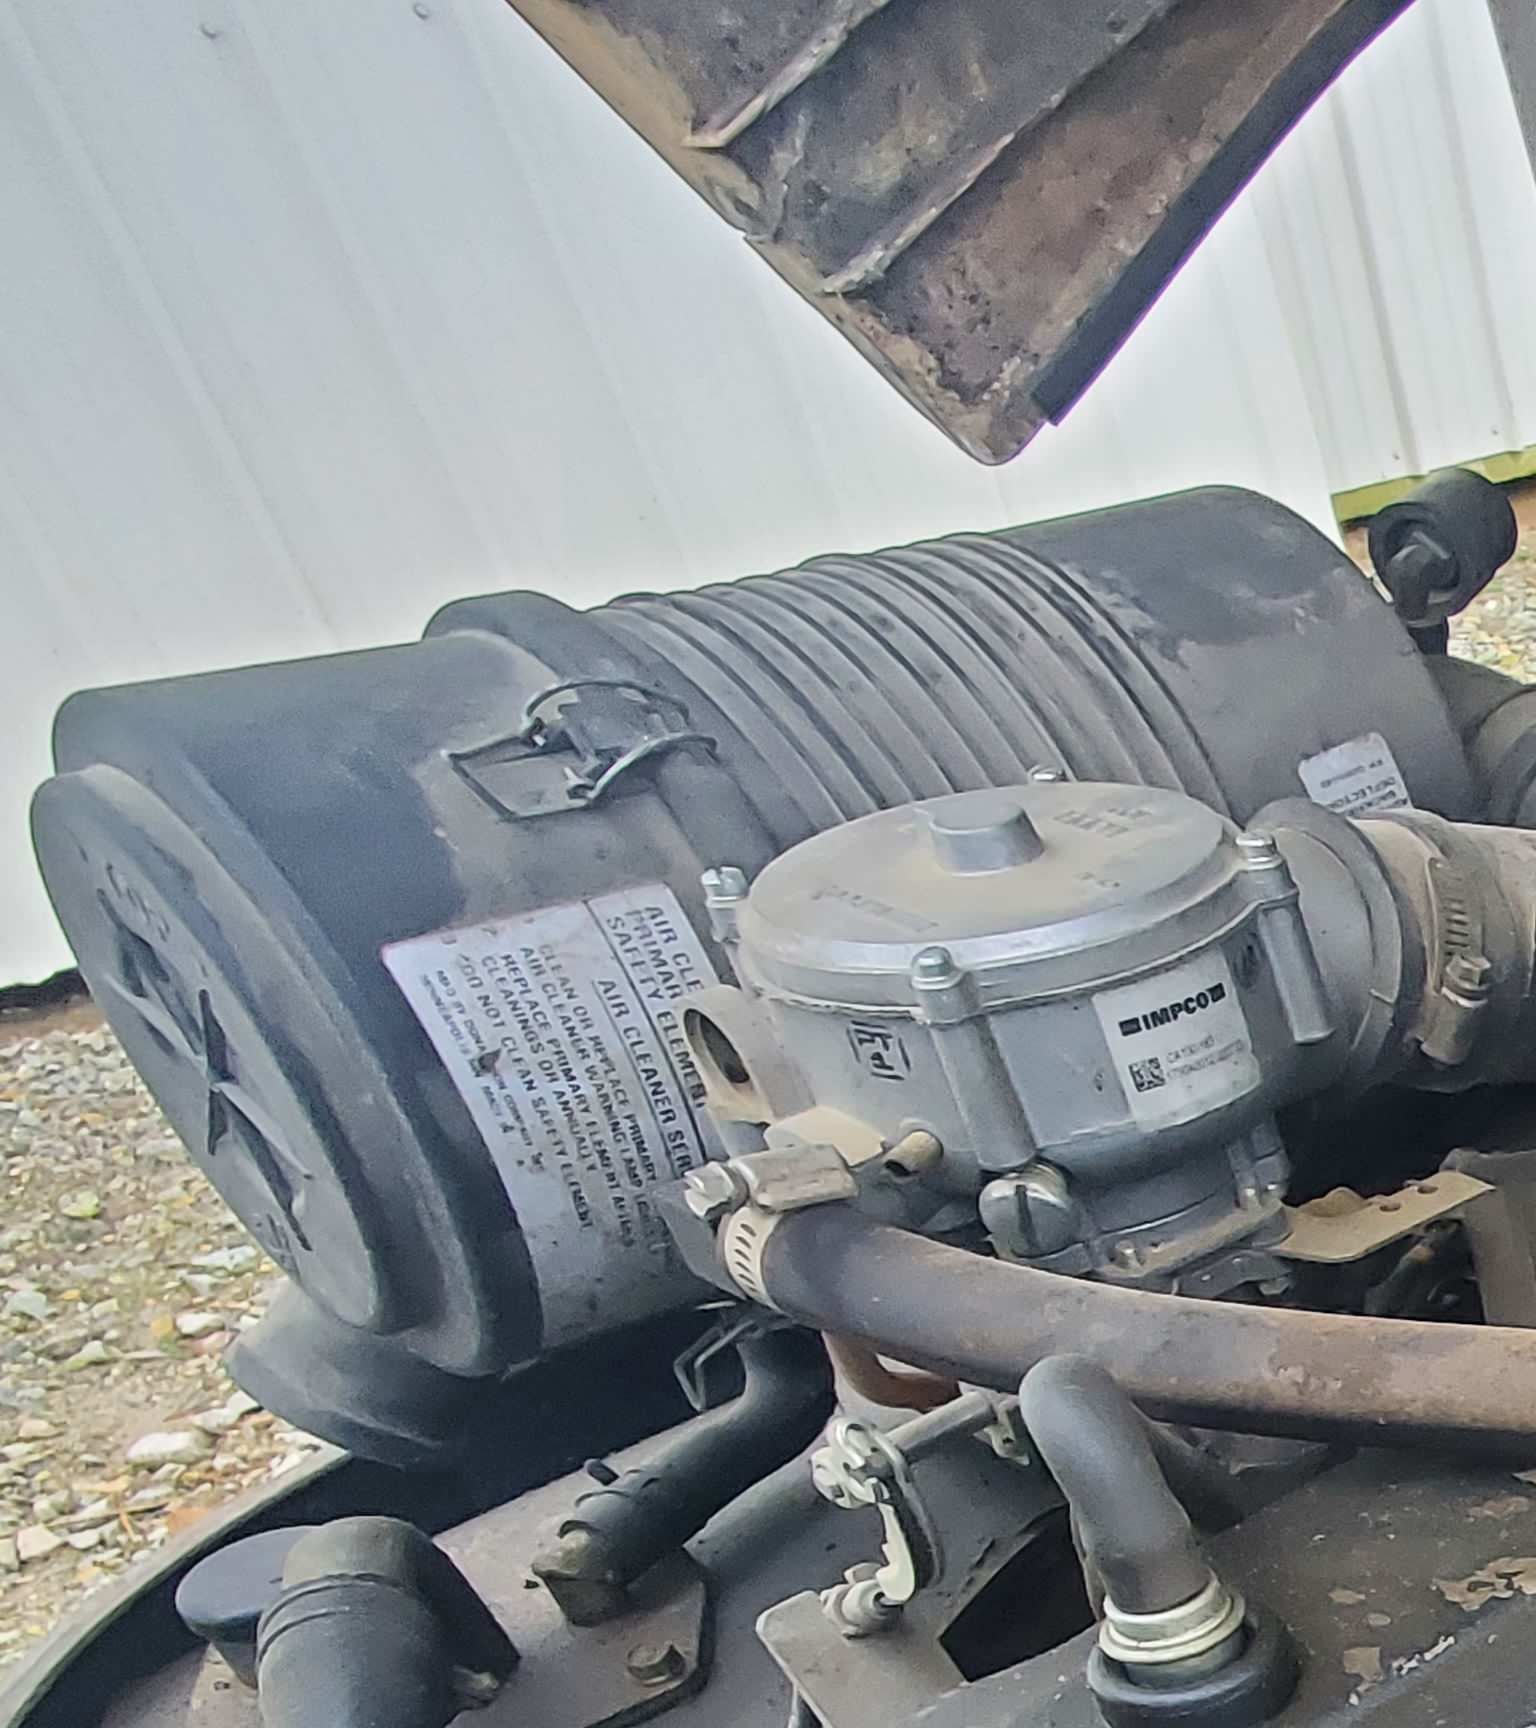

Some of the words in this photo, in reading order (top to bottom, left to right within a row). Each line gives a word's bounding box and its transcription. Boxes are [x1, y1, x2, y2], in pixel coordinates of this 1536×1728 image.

[605, 915, 663, 1001] SAFETY
[624, 907, 683, 999] PRIMAR
[643, 906, 678, 945] AIR
[476, 993, 508, 1032] NOT
[498, 1035, 537, 1093] CLEAN
[529, 1096, 567, 1158] SAFETY
[479, 955, 547, 1055] CLEANINGS
[538, 1057, 561, 1084] OR
[551, 1086, 598, 1174] ANNUALLY
[499, 952, 555, 1032] REPLACE
[545, 1037, 591, 1115] PRIMARY
[518, 945, 547, 978] AIR
[540, 982, 591, 1061] CLEANER
[583, 1065, 627, 1144] WARNING
[538, 942, 579, 1000] CLEAN
[573, 1004, 596, 1030] OR
[588, 1032, 630, 1107] REPLACE
[623, 1112, 658, 1183] PRIMARY
[596, 978, 631, 1018] AIR
[622, 1025, 678, 1123] CLEANER
[1139, 988, 1210, 1031] IMPCO
